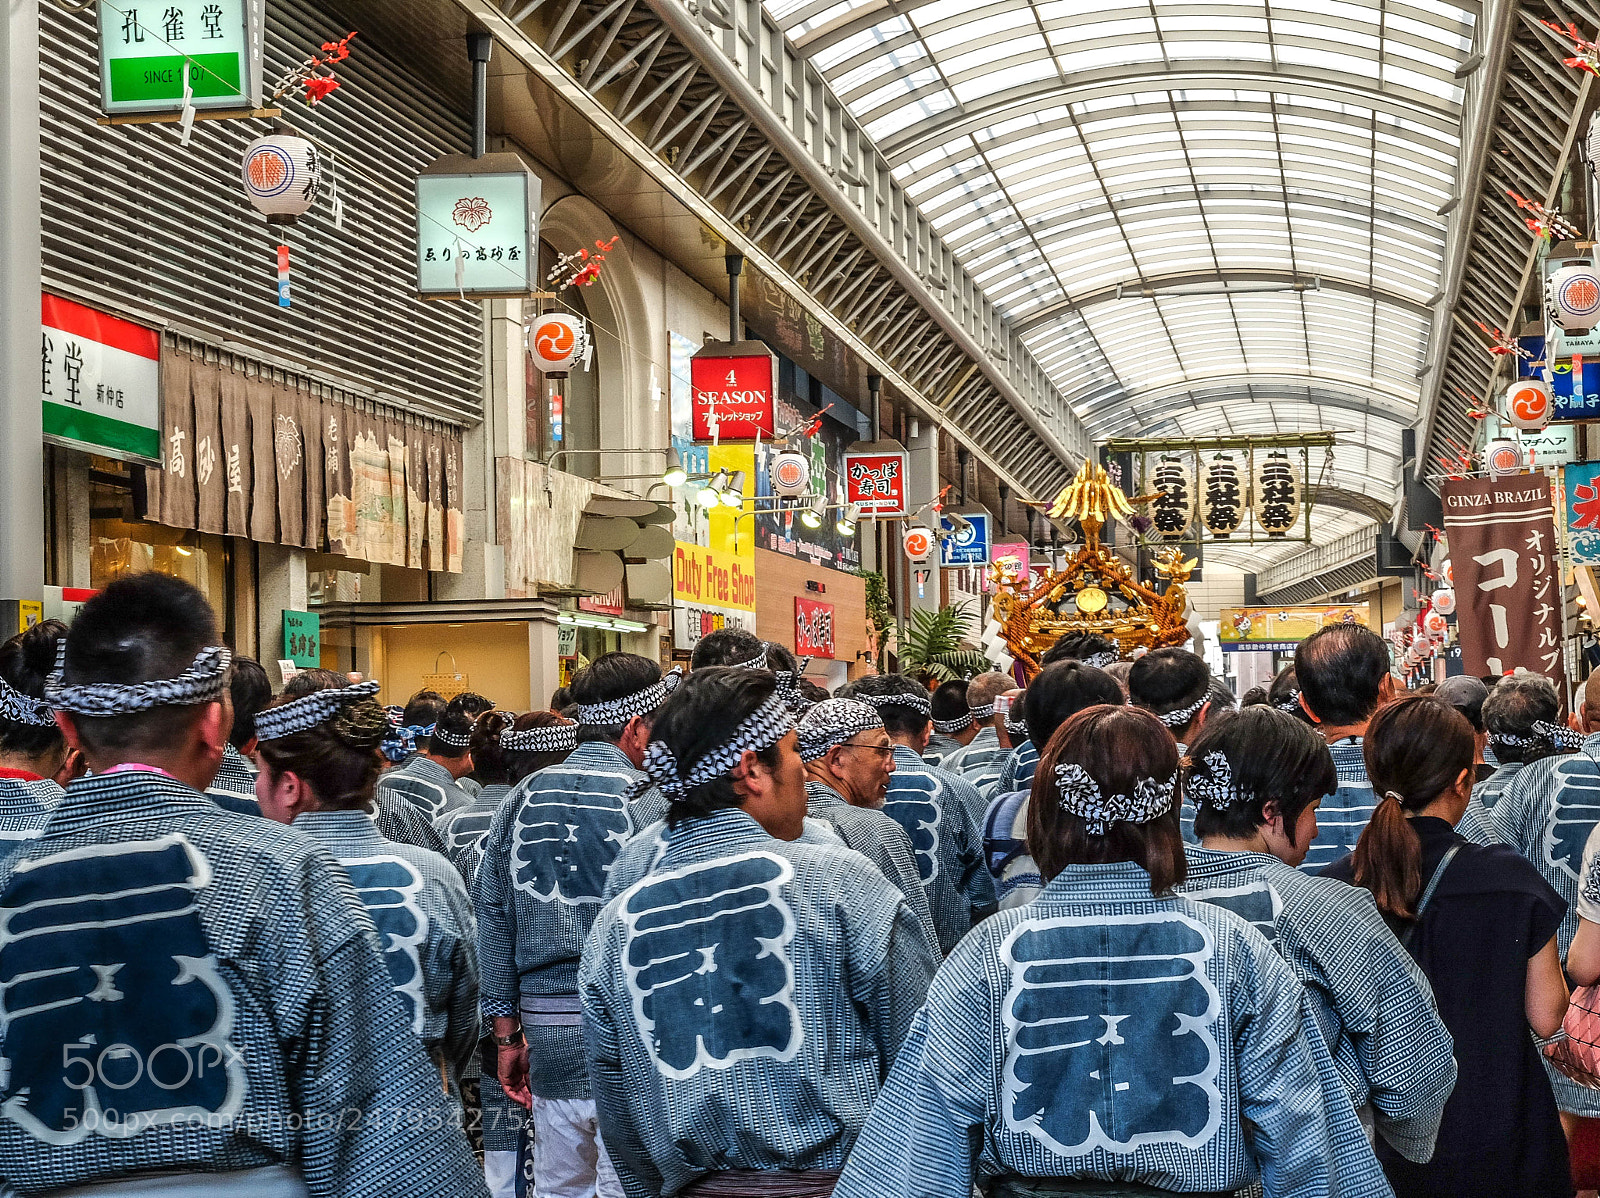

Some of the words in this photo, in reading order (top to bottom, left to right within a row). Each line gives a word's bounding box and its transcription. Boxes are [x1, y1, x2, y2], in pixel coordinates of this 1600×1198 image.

[121, 4, 224, 44] 孔雀堂
[144, 70, 173, 84] SINCE
[177, 66, 206, 82] 107
[725, 370, 736, 384] 4
[97, 383, 124, 409] 新仲店
[697, 390, 766, 405] SEASON
[702, 411, 763, 422] アトレットショップ
[169, 426, 243, 495] 高砂屋
[851, 461, 899, 479] かっぱ
[858, 478, 891, 496] 寿司
[1152, 465, 1189, 532] 三社祭
[1206, 464, 1241, 530] 三社祭
[1259, 462, 1296, 529] 三社祭
[1447, 493, 1492, 508] GINZA
[1494, 488, 1546, 504] BRAZIL
[677, 547, 702, 600] Duty
[706, 555, 729, 602] Free
[732, 563, 754, 608] Shop
